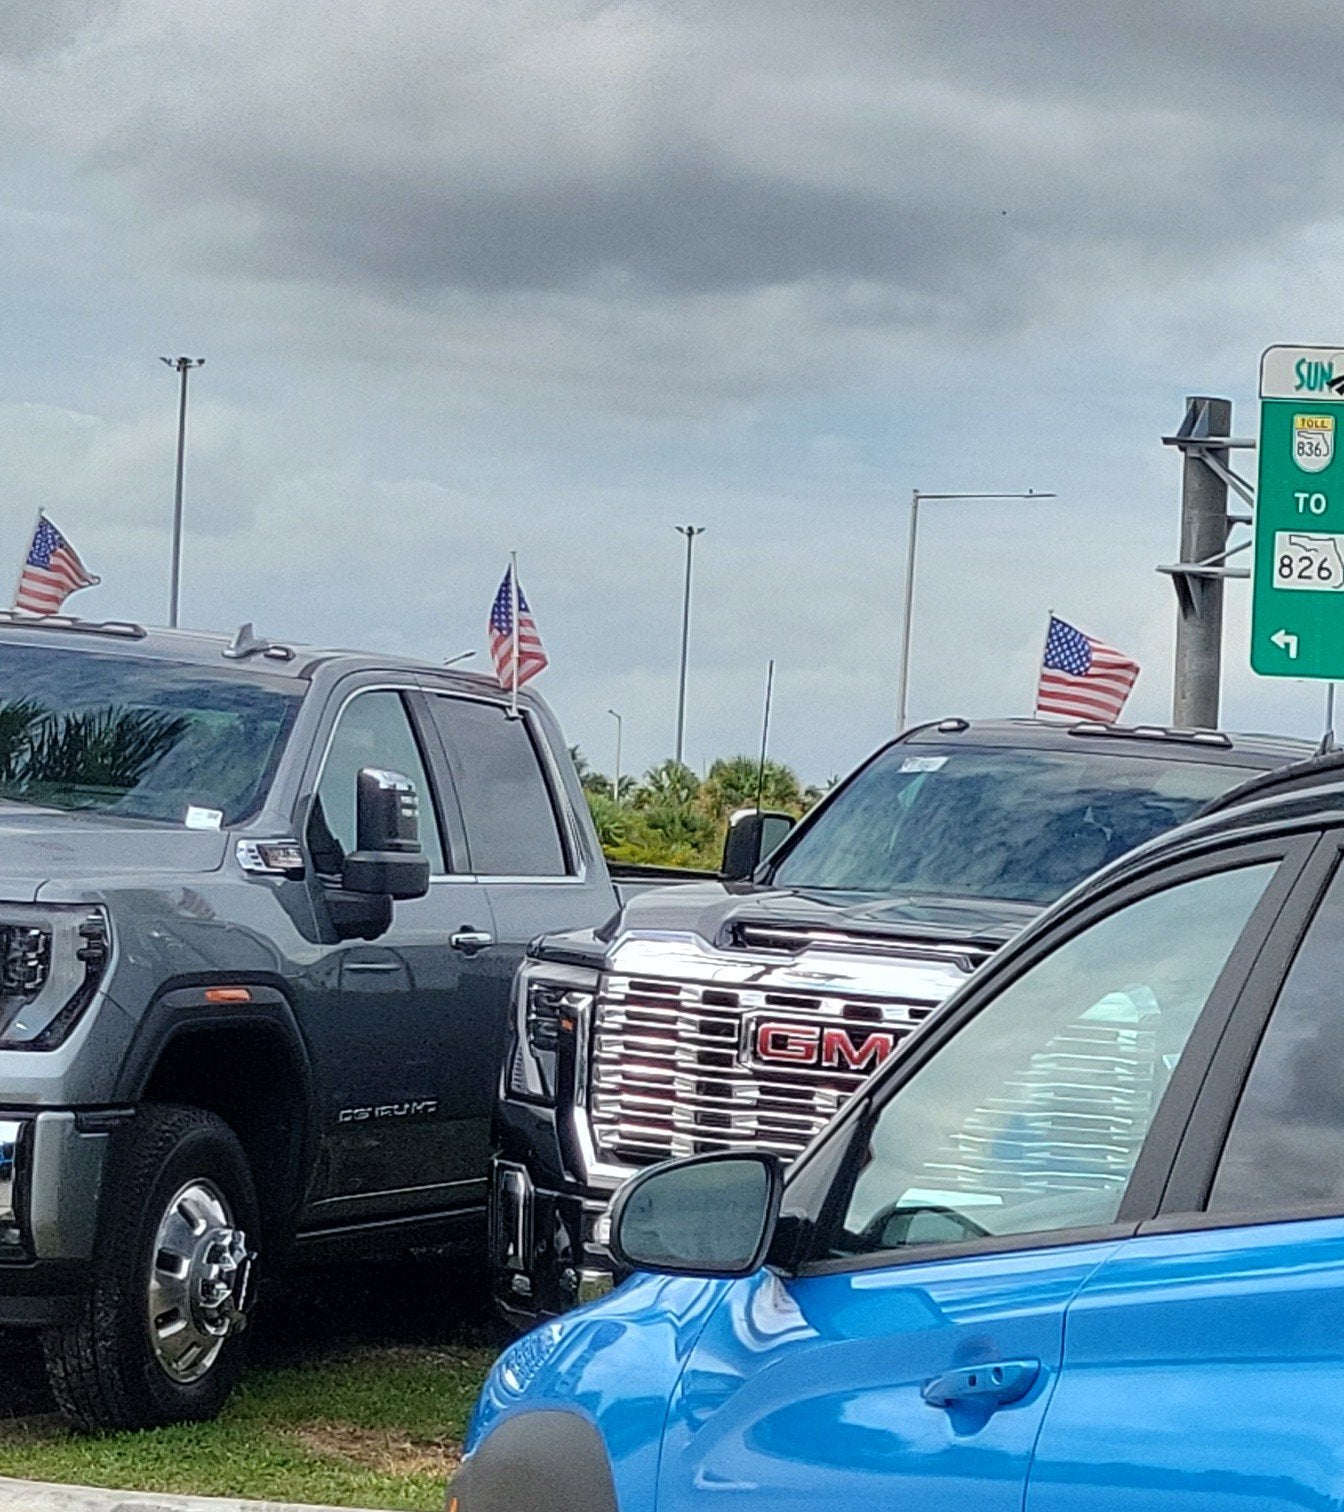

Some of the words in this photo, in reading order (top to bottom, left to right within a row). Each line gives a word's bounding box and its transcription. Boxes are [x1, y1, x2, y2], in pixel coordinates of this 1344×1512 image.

[1299, 418, 1328, 429] TOLL
[1296, 441, 1322, 458] 836
[1294, 492, 1327, 515] TO
[1278, 554, 1333, 581] 826
[757, 1022, 894, 1071] GM
